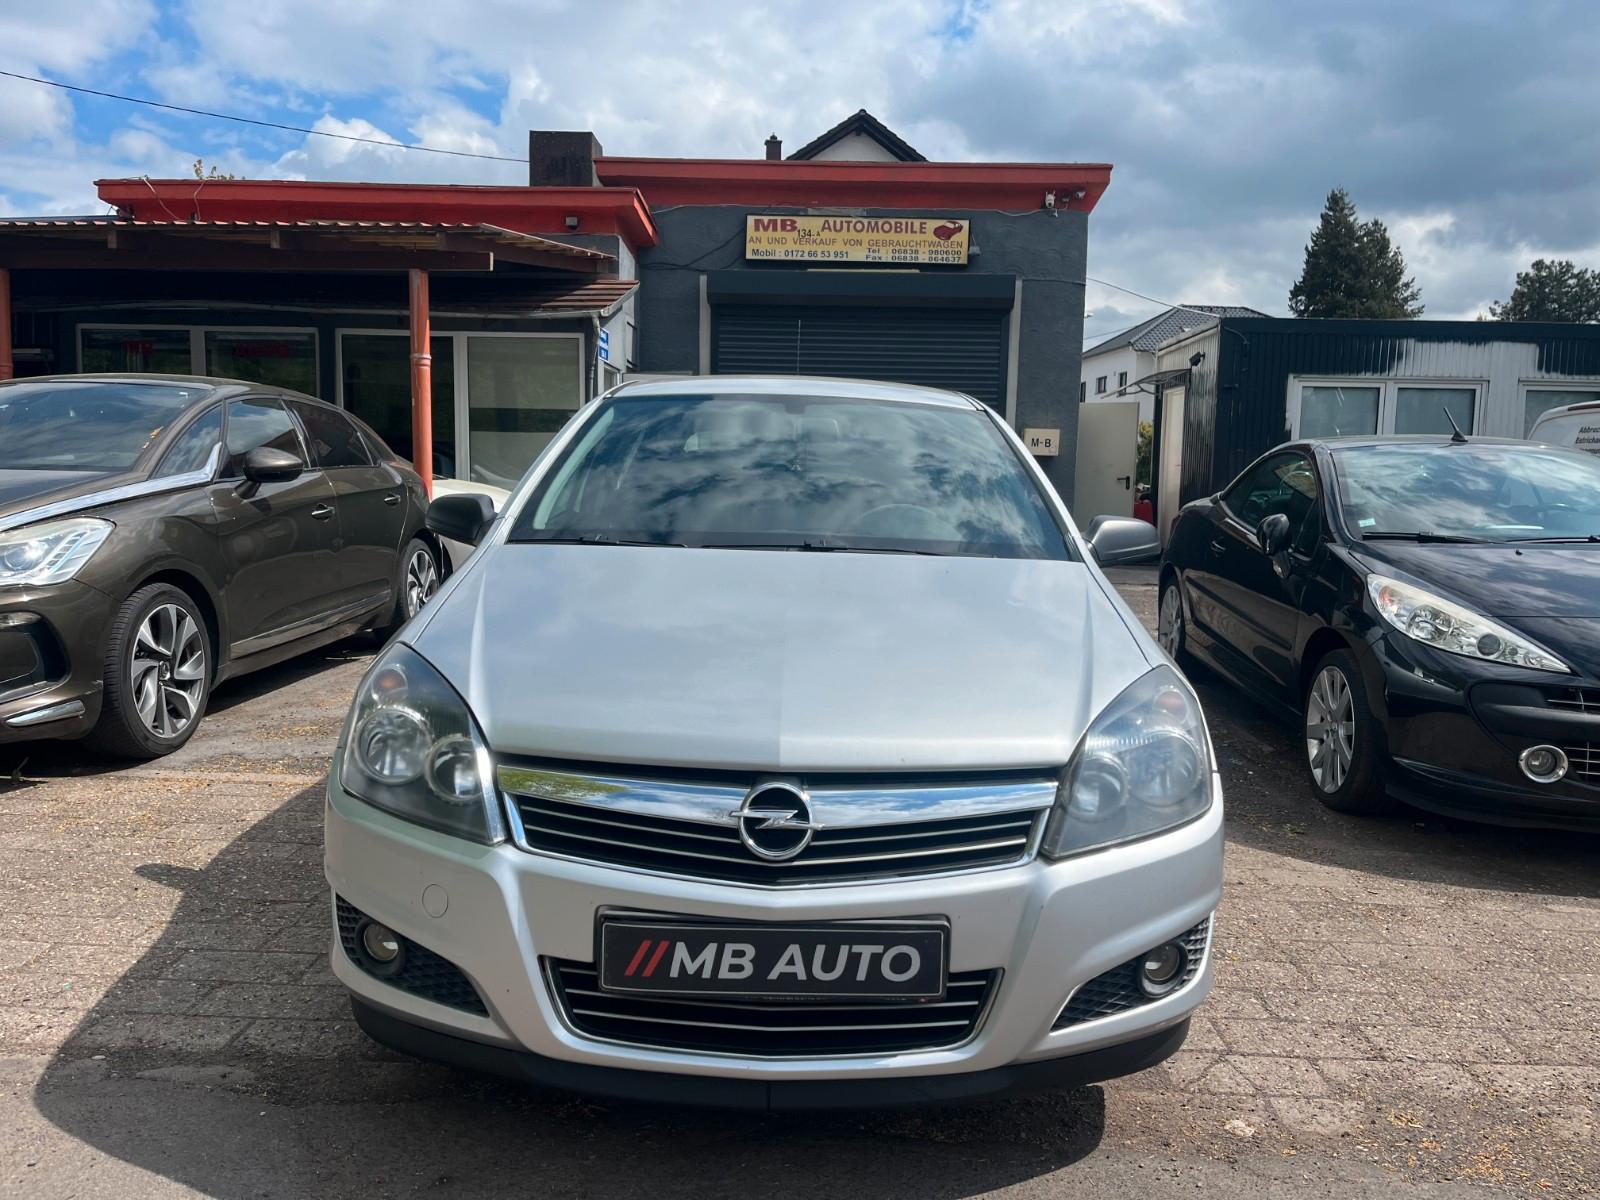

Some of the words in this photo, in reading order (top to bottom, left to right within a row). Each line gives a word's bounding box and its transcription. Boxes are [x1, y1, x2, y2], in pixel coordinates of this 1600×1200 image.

[753, 218, 798, 233] MB
[821, 220, 927, 234] AUTOMOBILE
[748, 236, 762, 245] AN
[767, 236, 788, 246] UND
[793, 237, 837, 247] VERKAUF
[843, 238, 863, 248] VON
[867, 239, 963, 249] GEBRAUCHTWAGEN
[751, 249, 776, 257] Mobil
[784, 250, 806, 258] 0172
[820, 251, 831, 259] 53
[833, 251, 849, 259] 951
[1031, 438, 1051, 448] M-B
[766, 944, 921, 982] AUTO
